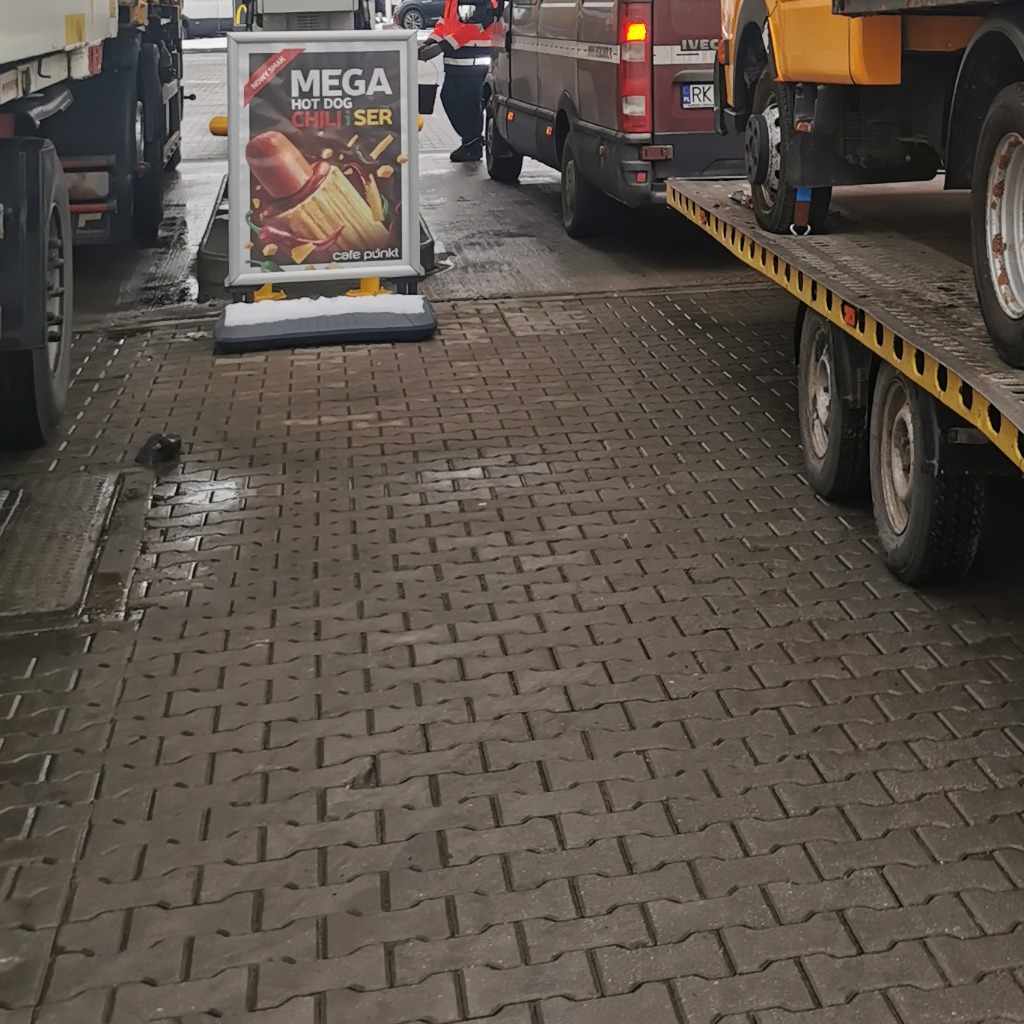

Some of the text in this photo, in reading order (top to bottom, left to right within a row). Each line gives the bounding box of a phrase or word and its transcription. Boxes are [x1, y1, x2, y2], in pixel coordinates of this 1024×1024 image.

[681, 39, 719, 50] IVEC
[250, 55, 287, 90] NOWY SMAK
[290, 67, 393, 98] MEGA
[291, 97, 353, 110] HOT DOG
[291, 110, 342, 128] CHILI
[353, 109, 393, 127] SER
[332, 249, 361, 261] cafe
